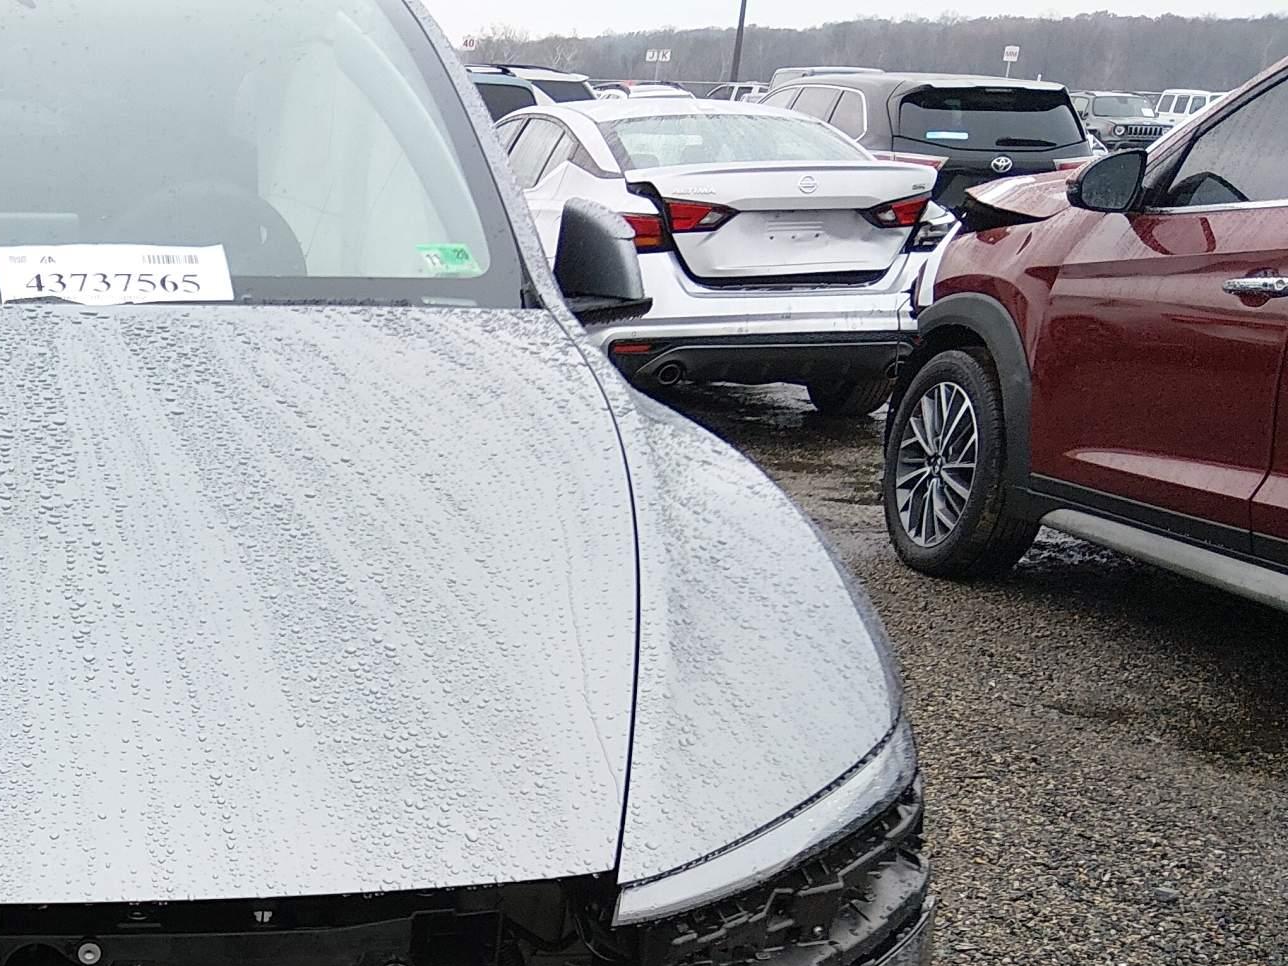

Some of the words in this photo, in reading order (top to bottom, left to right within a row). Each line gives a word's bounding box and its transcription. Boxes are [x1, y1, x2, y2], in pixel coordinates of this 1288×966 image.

[462, 38, 475, 48] 40
[648, 50, 655, 59] J
[662, 50, 670, 59] K
[26, 273, 201, 293] 43737565
